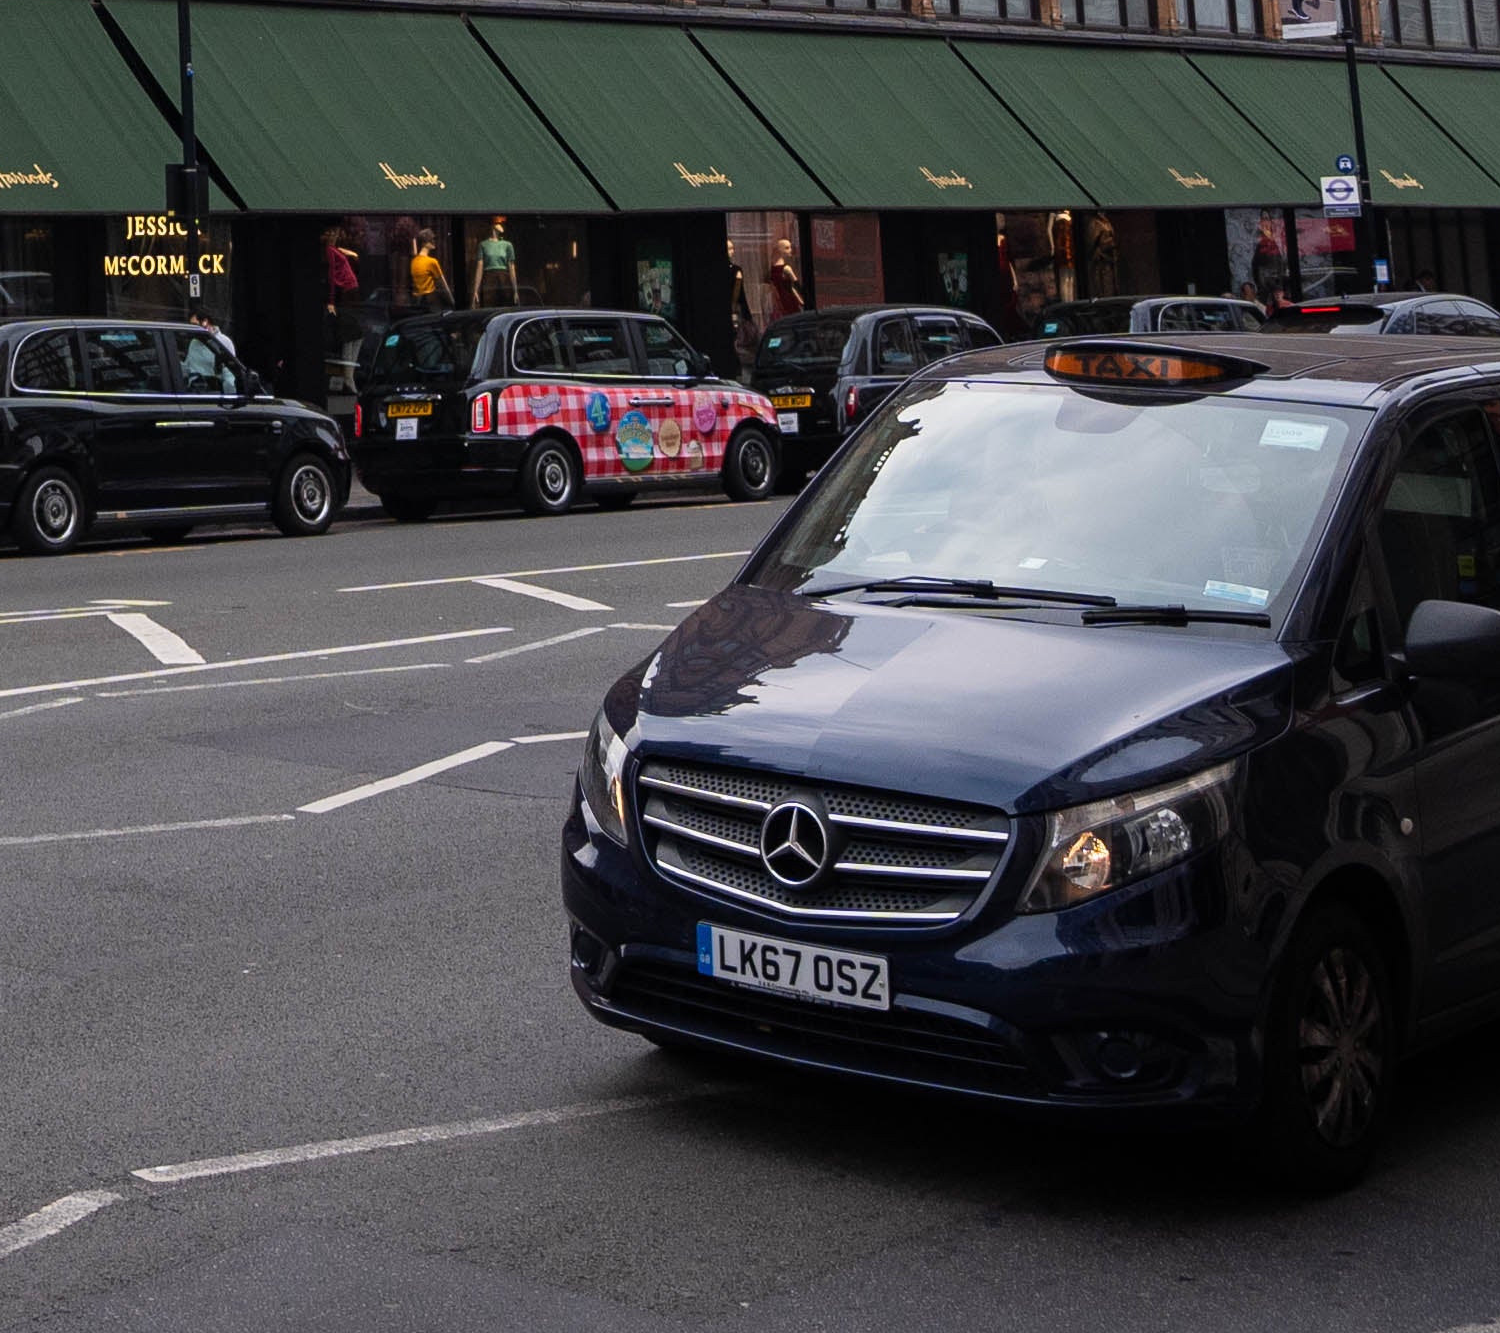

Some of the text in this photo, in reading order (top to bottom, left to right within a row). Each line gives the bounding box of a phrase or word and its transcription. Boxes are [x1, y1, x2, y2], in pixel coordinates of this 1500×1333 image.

[378, 162, 446, 190] Harrods
[673, 162, 734, 189] Harrods
[104, 254, 225, 276] McCORMCK
[1076, 354, 1169, 379] TAXI
[718, 934, 802, 986] LK67
[813, 954, 882, 1002] OSZ
